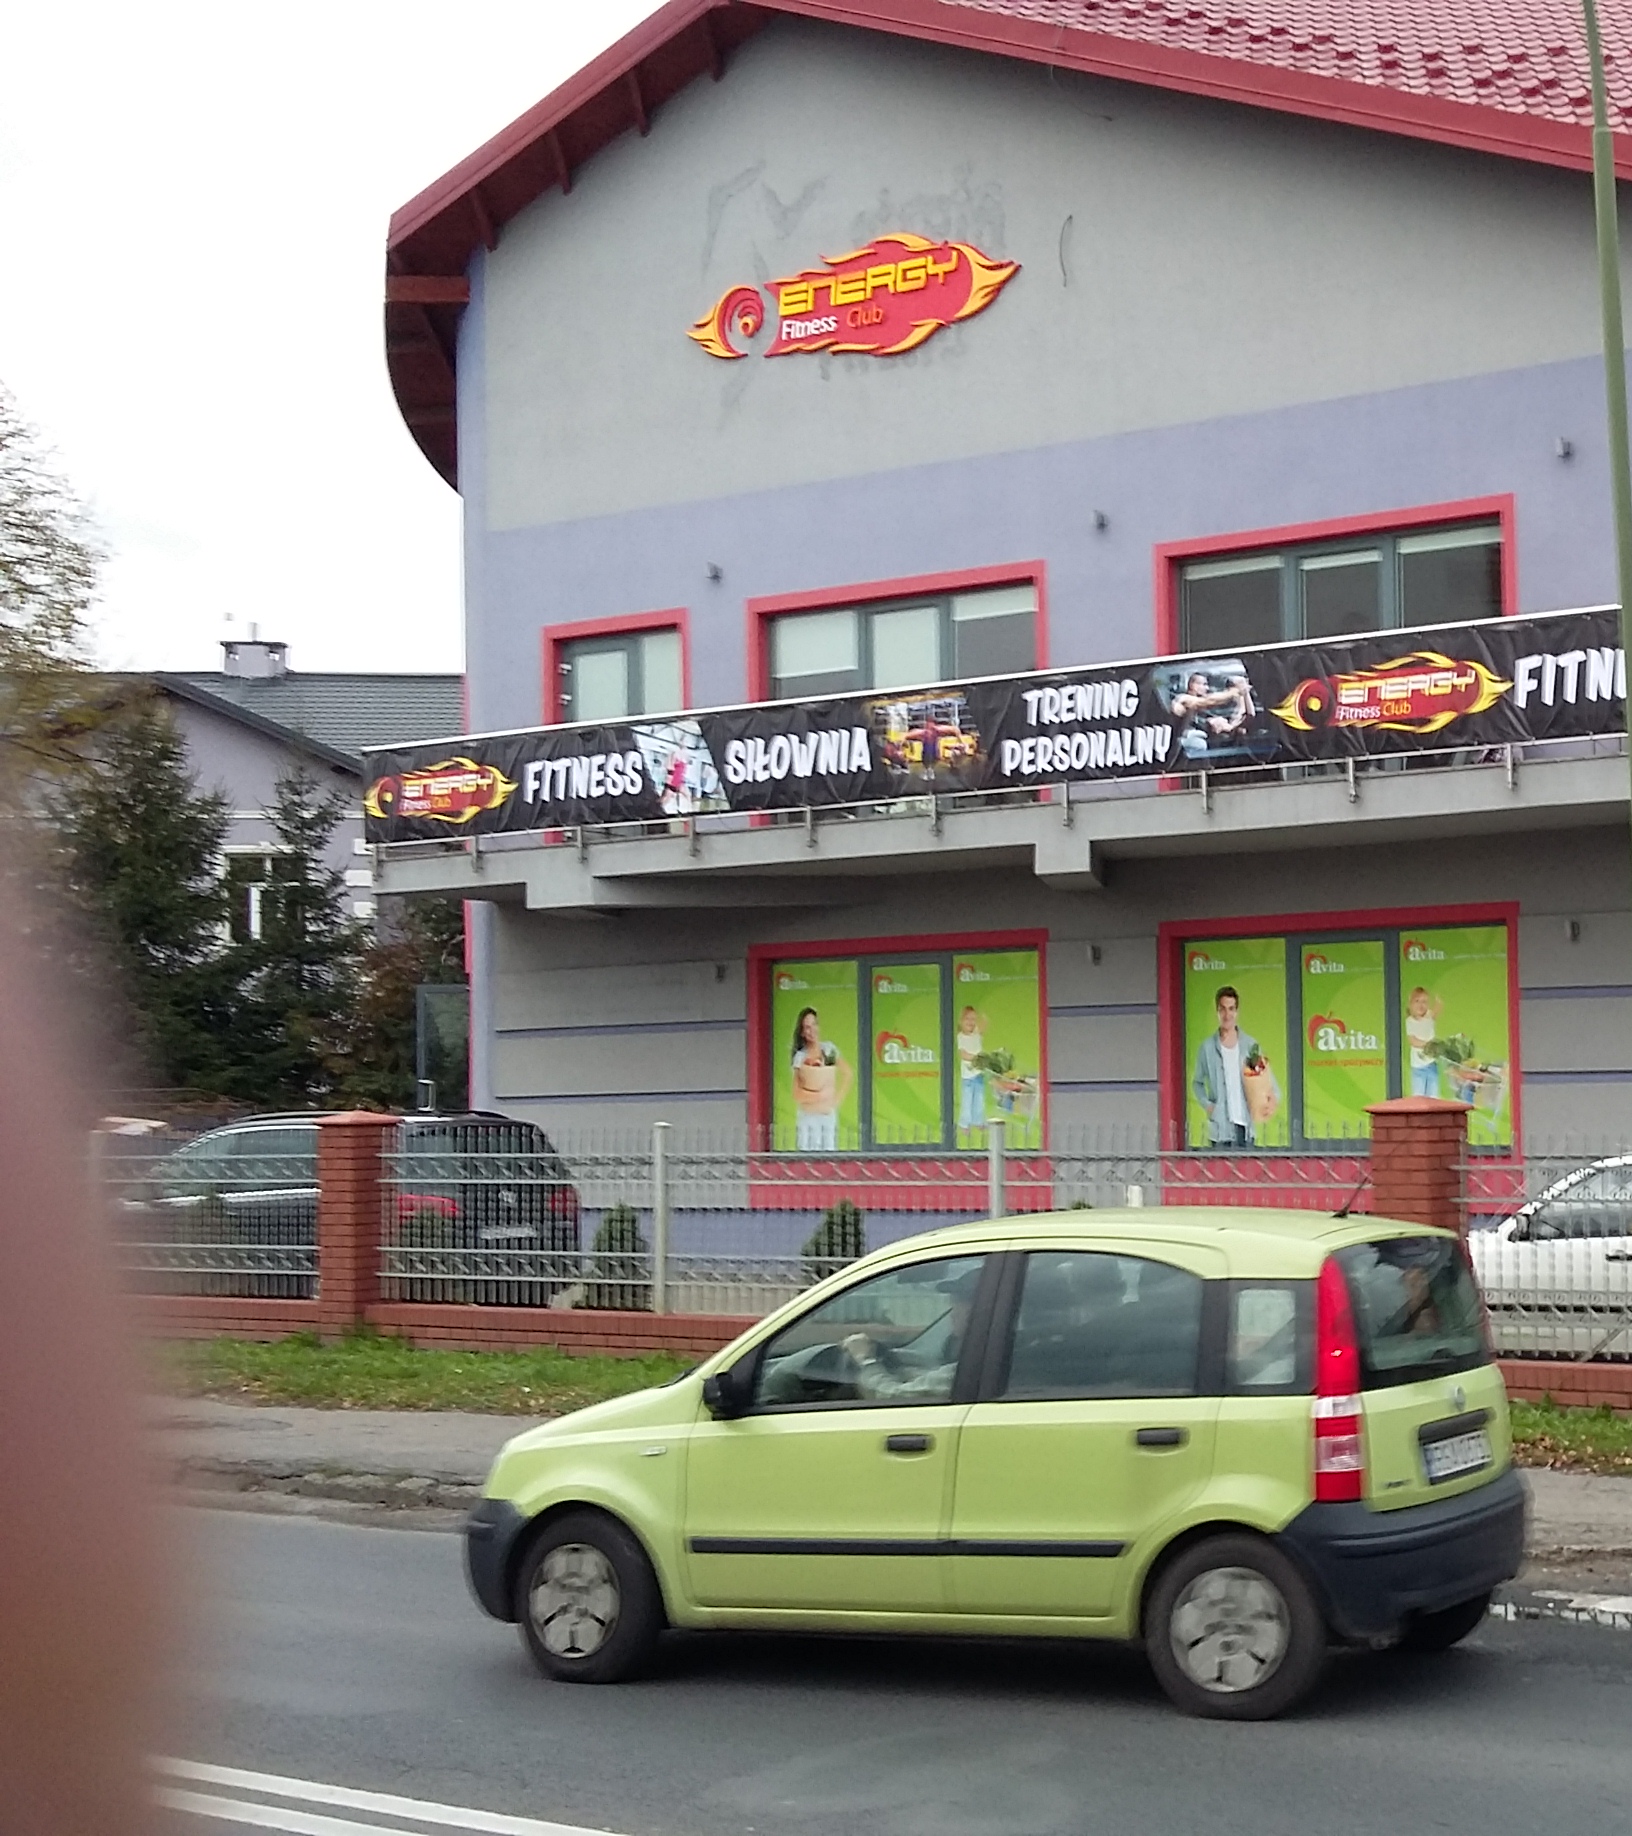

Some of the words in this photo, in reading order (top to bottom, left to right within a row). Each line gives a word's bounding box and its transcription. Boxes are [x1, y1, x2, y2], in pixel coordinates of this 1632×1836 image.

[779, 251, 958, 316] ENERGY
[781, 314, 838, 341] Fitness
[846, 304, 883, 328] Club
[1336, 668, 1476, 705] ENERGY
[1021, 678, 1139, 727] TRENING
[1334, 703, 1381, 720] Fitness
[1382, 700, 1412, 717] Club
[723, 727, 872, 784] SIŁOWNIA
[1000, 724, 1172, 778] PERSONALNY
[523, 751, 643, 803] FITNESS
[1192, 956, 1226, 971] avita
[1309, 958, 1345, 974] avita
[1408, 944, 1445, 960] avita
[959, 968, 991, 983] avita
[884, 1042, 934, 1064] avita
[1318, 1027, 1378, 1051] avita
